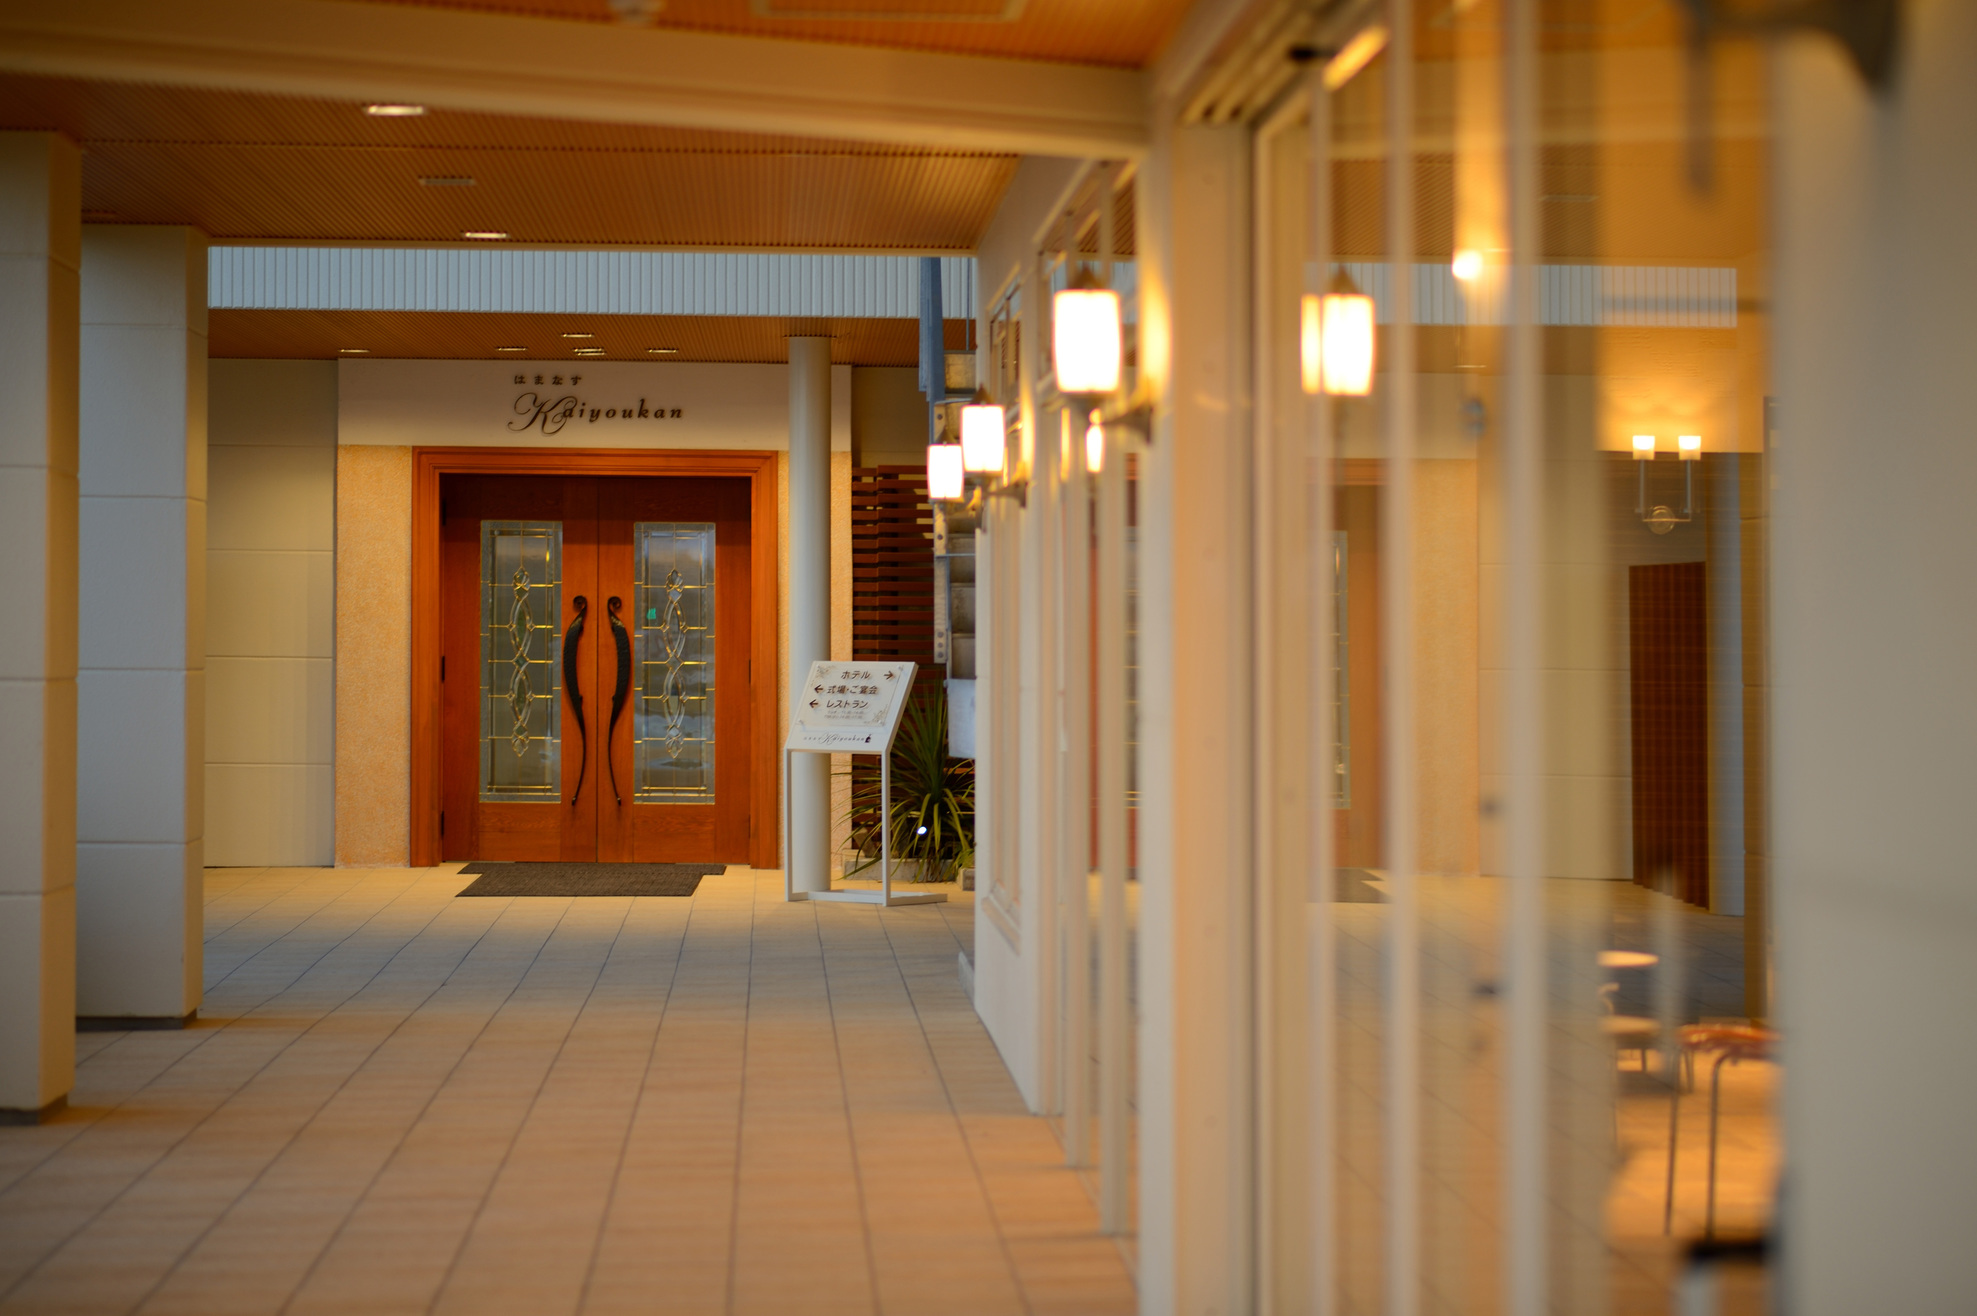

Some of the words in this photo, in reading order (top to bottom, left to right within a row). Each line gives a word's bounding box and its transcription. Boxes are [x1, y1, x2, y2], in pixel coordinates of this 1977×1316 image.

[514, 375, 582, 385] はまなす
[507, 392, 682, 434] Kaiyoukan
[841, 671, 871, 679] ホテル
[826, 700, 868, 708] レストラン
